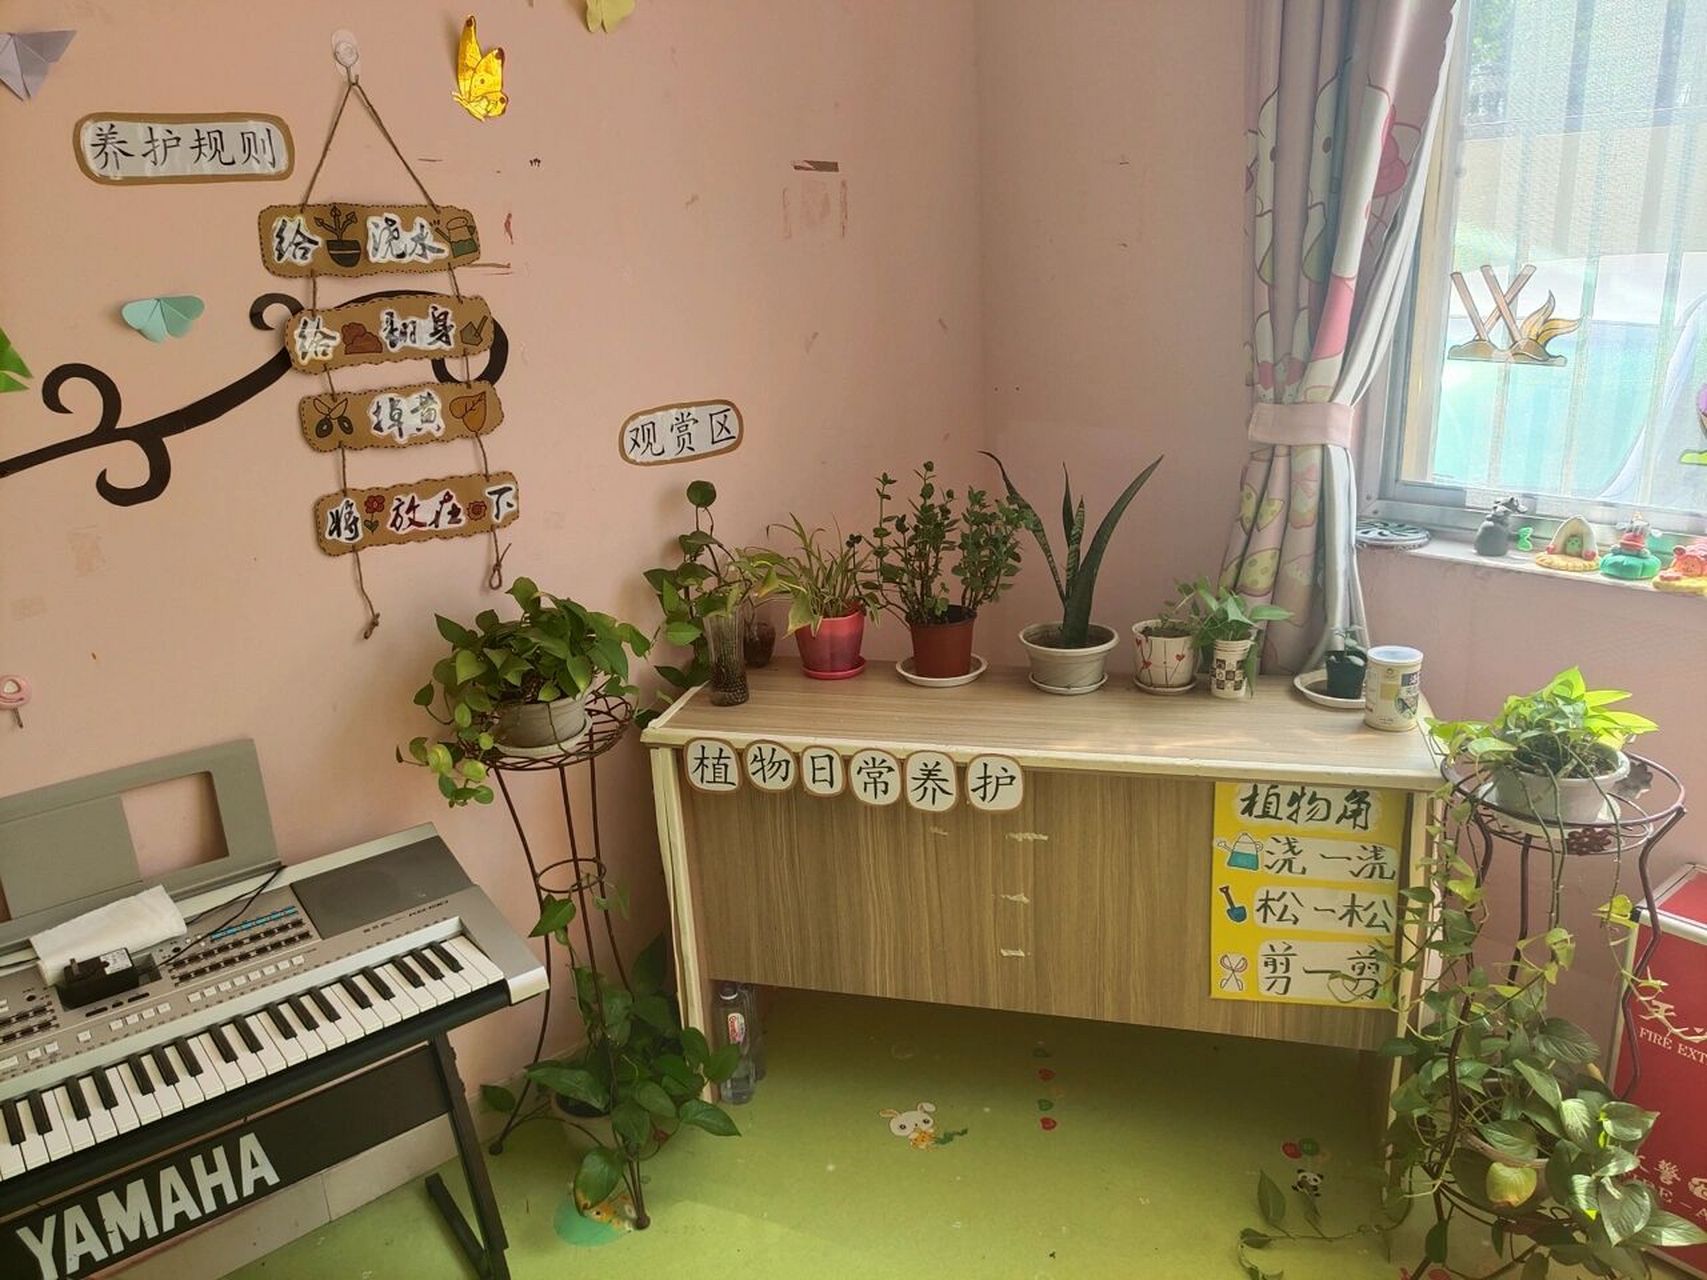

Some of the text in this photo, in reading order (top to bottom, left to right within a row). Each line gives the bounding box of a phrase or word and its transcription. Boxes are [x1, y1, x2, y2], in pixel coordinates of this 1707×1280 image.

[91, 123, 276, 169] 养护规则
[273, 215, 446, 262] 给 浇水
[628, 408, 737, 457] 观赏区
[328, 486, 514, 541] 将 放在 下
[691, 744, 1017, 806] 植物日常养护
[1240, 783, 1372, 830] 植物角
[1264, 836, 1397, 881] 浇一浇
[1256, 889, 1395, 933] 松一松
[1261, 941, 1381, 1000] 剪一剪
[1639, 1026, 1673, 1050] FIRE
[16, 1132, 281, 1280] YAMAHA
